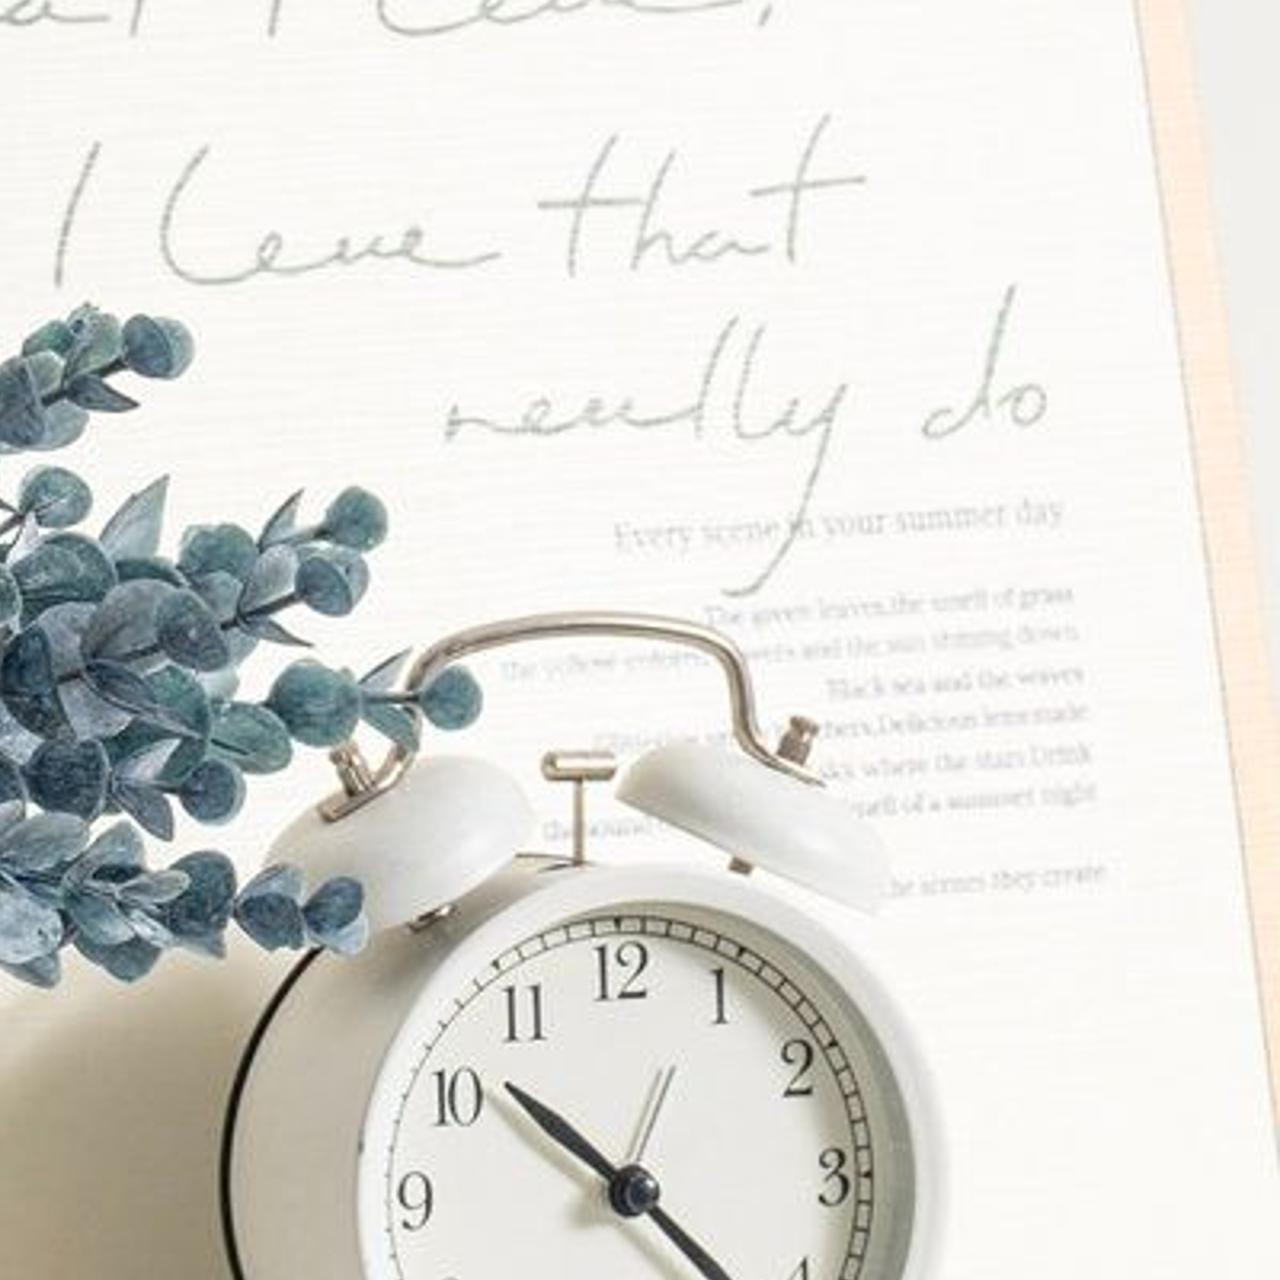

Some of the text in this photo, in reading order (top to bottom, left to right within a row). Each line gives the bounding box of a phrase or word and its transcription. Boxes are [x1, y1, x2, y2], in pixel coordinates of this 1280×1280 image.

[53, 141, 101, 288] I
[537, 114, 866, 276] that
[444, 285, 1047, 599] really do
[614, 520, 693, 557] Every
[701, 518, 781, 545] scene
[823, 515, 886, 543] your
[893, 506, 1008, 535] summer
[1016, 497, 1064, 529] day
[593, 939, 650, 1003] 12
[707, 966, 732, 1025] 1
[501, 982, 548, 1044] 11
[431, 1066, 485, 1127] 10
[780, 1035, 817, 1099] 2
[396, 1170, 434, 1233] 9
[817, 1146, 852, 1209] 3
